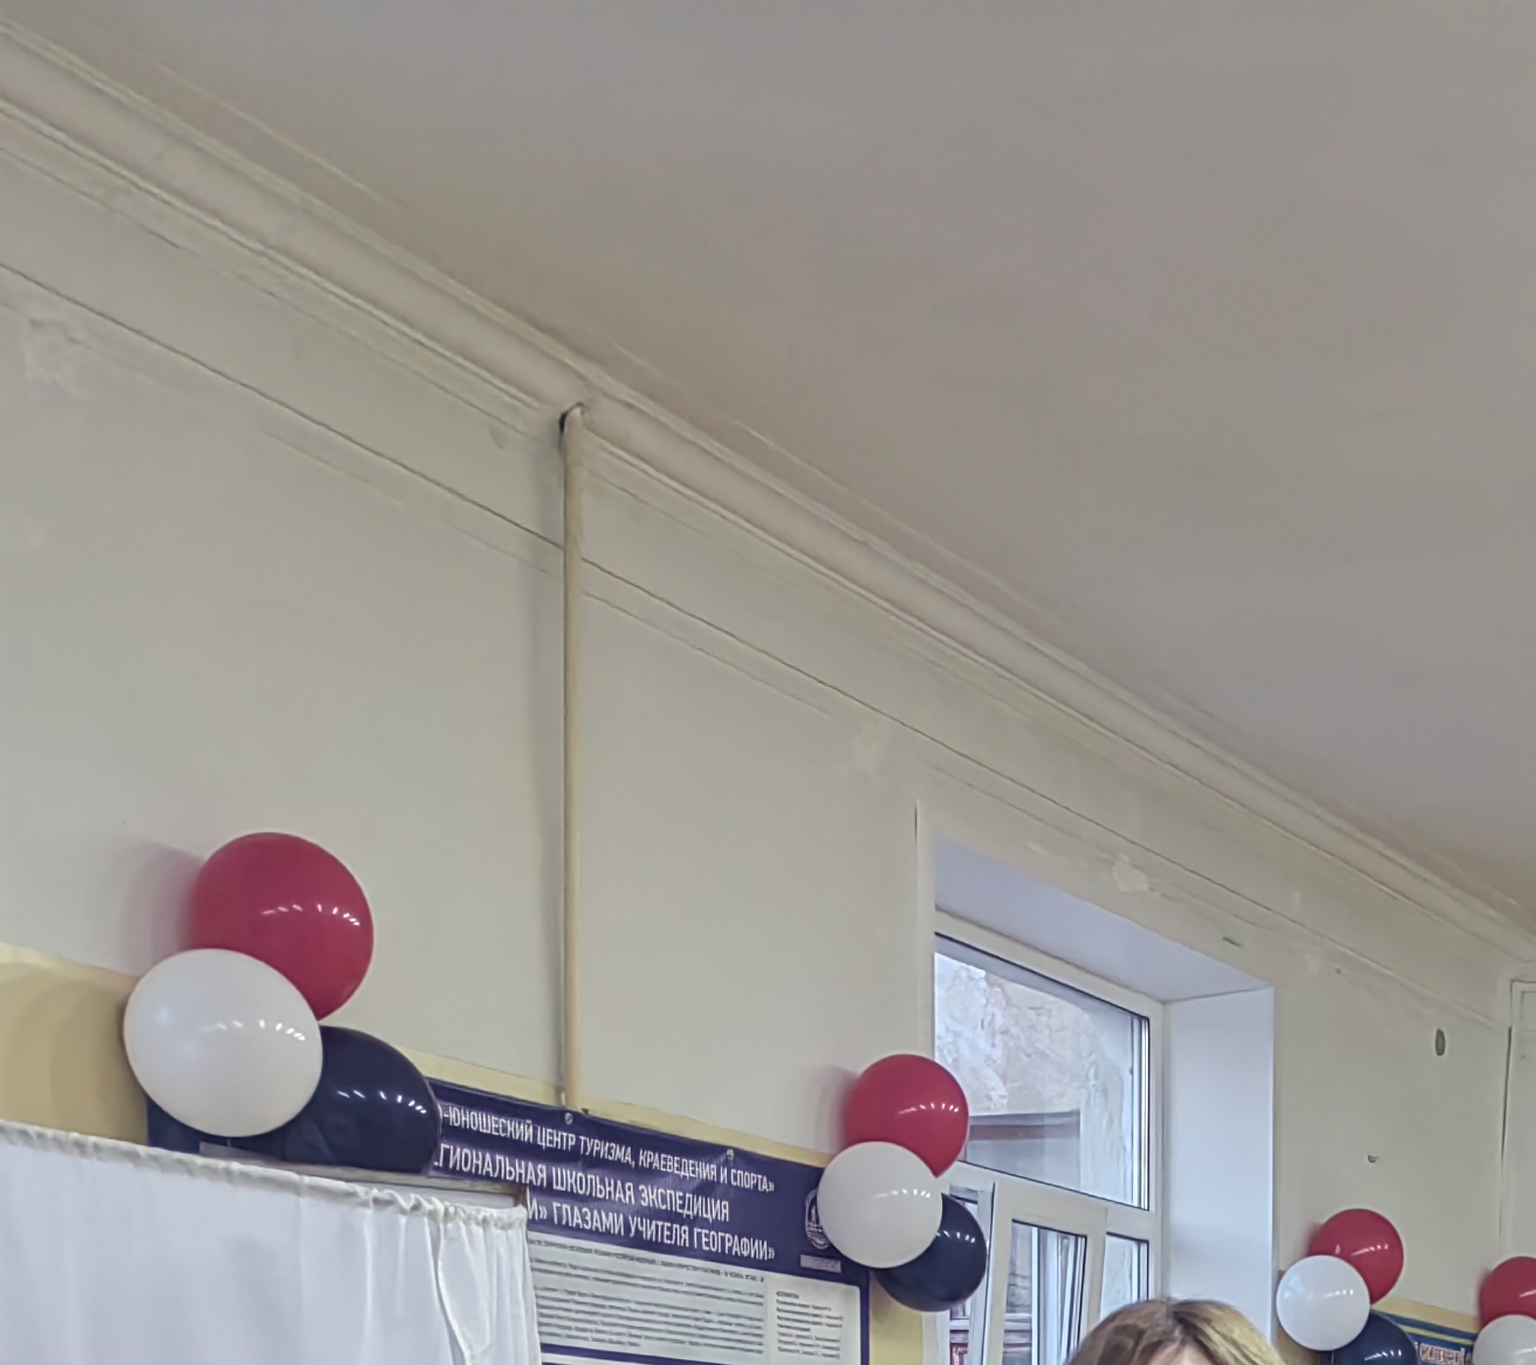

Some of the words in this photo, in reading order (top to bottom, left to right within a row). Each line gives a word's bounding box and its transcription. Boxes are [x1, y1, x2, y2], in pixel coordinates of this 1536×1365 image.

[434, 1143, 547, 1187] ГИОНАЛЬНАЯ
[552, 1166, 635, 1205] ШКОЛЬНАЯ
[638, 1184, 730, 1223] ЭКСПЕДИЦИЯ
[537, 1125, 576, 1149] ЦЕНТР
[579, 1135, 635, 1168] ТУРИЗМА,
[639, 1148, 717, 1182] КРАЕВЕДЕНИЯ
[720, 1166, 728, 1184] И
[730, 1168, 774, 1193] СПОРТА»
[553, 1201, 624, 1236] ГЛАЗАМИ
[628, 1214, 690, 1248] УЧИТЕЛЯ
[693, 1227, 775, 1261] ГЕОГРАФИИ»
